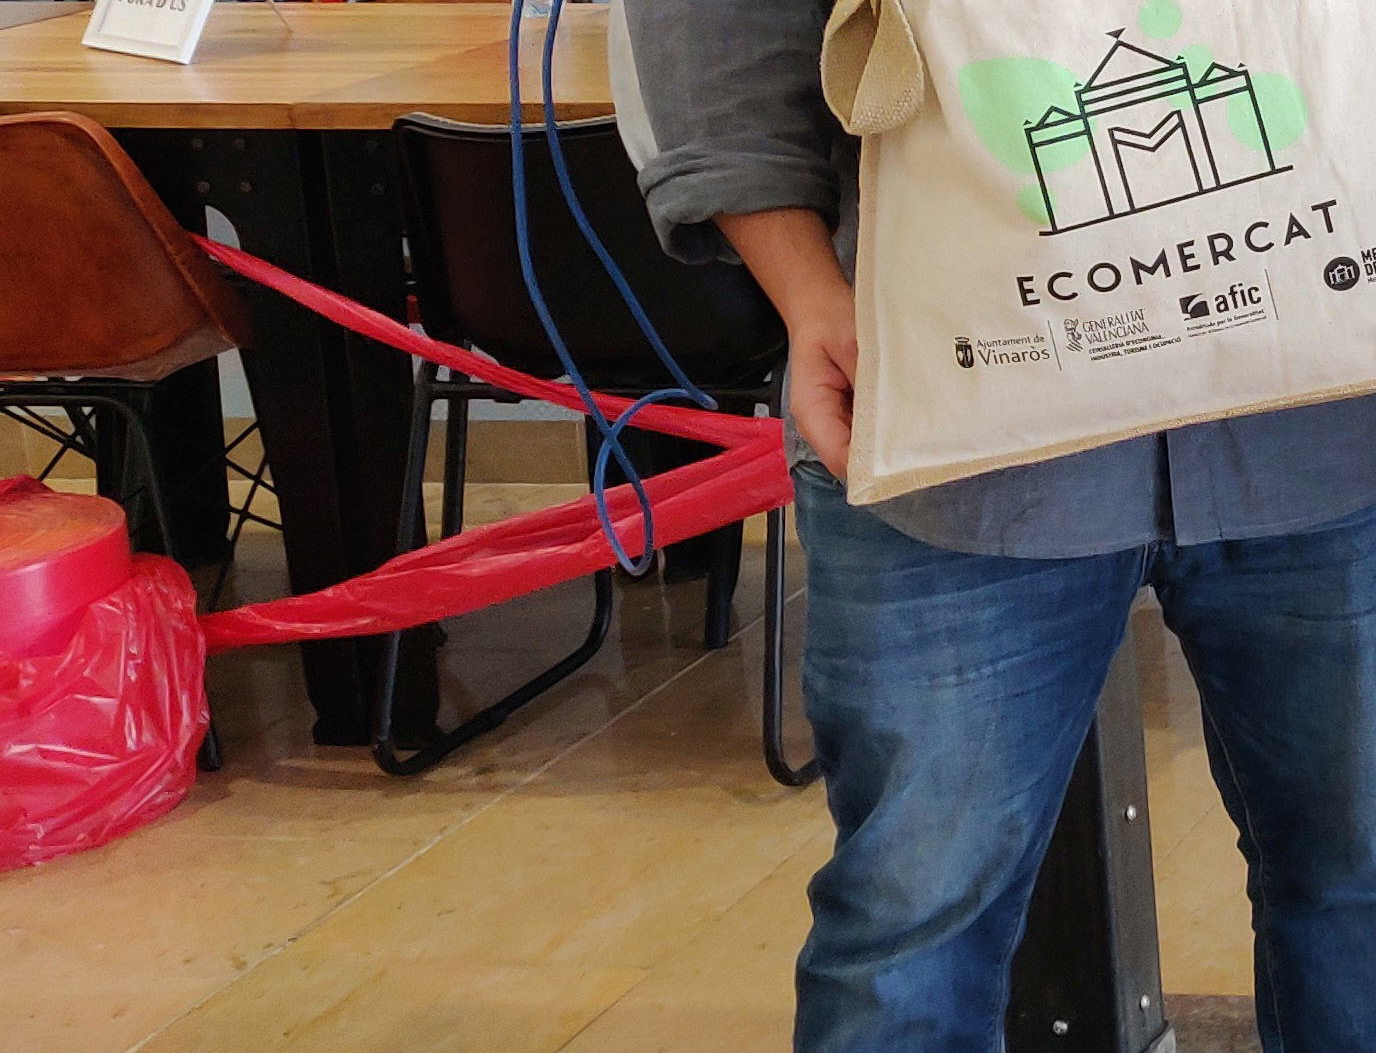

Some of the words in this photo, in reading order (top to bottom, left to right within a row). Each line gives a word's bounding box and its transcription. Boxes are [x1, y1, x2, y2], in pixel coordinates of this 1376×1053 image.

[1016, 198, 1339, 308] ECOMERCAT
[1214, 282, 1262, 314] afic
[1082, 308, 1145, 333] GENERALITAT
[976, 336, 1031, 350] Ajuntament
[1033, 334, 1045, 344] de
[1084, 322, 1150, 345] VALENCIANA
[978, 345, 1050, 366] Vinaròs
